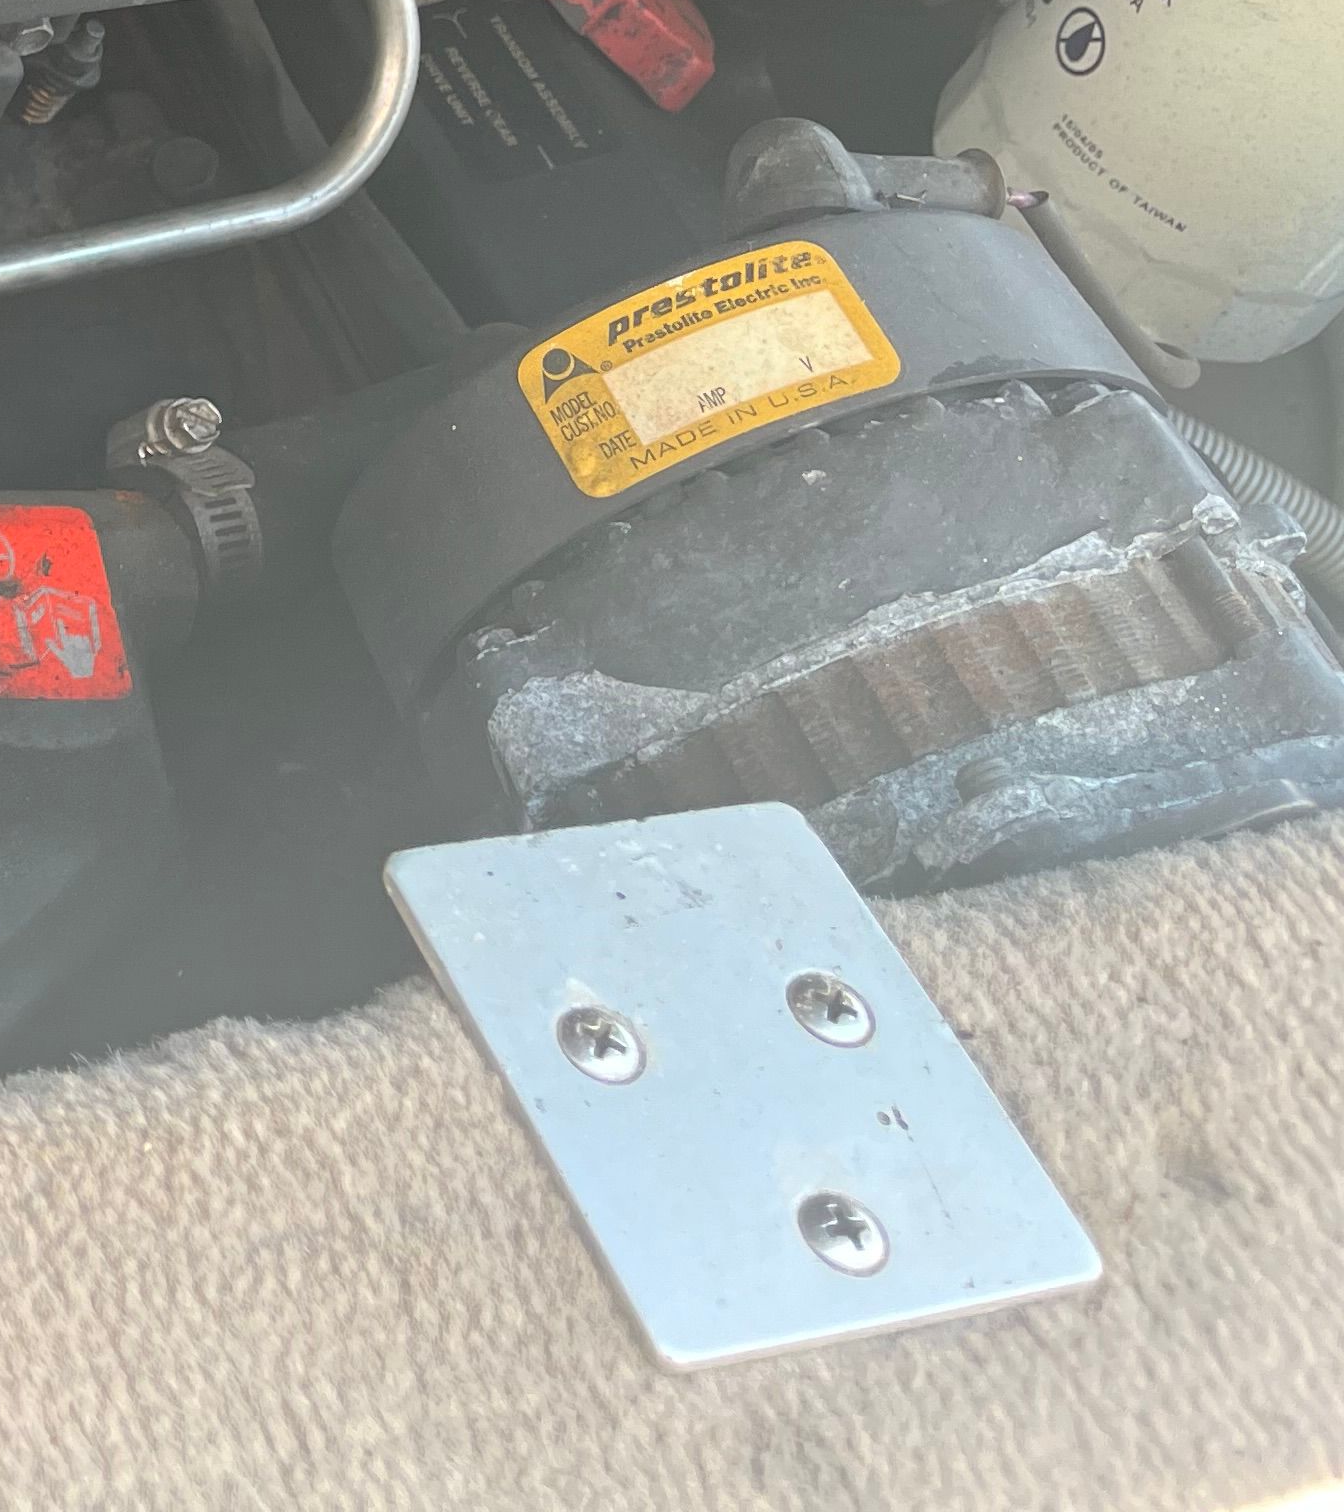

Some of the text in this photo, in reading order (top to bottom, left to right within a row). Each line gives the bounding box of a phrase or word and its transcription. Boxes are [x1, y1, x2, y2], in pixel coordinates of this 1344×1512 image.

[1051, 121, 1188, 233] PRODUCT OF TAIWAN
[608, 251, 812, 347] prestolite
[621, 308, 713, 354] Prestolite
[713, 282, 790, 316] Electric
[798, 356, 814, 373] V
[549, 391, 597, 428] MODEL
[697, 386, 727, 413] AMP
[598, 428, 639, 460] DATE
[630, 420, 717, 470] MADE
[730, 404, 759, 426] IN
